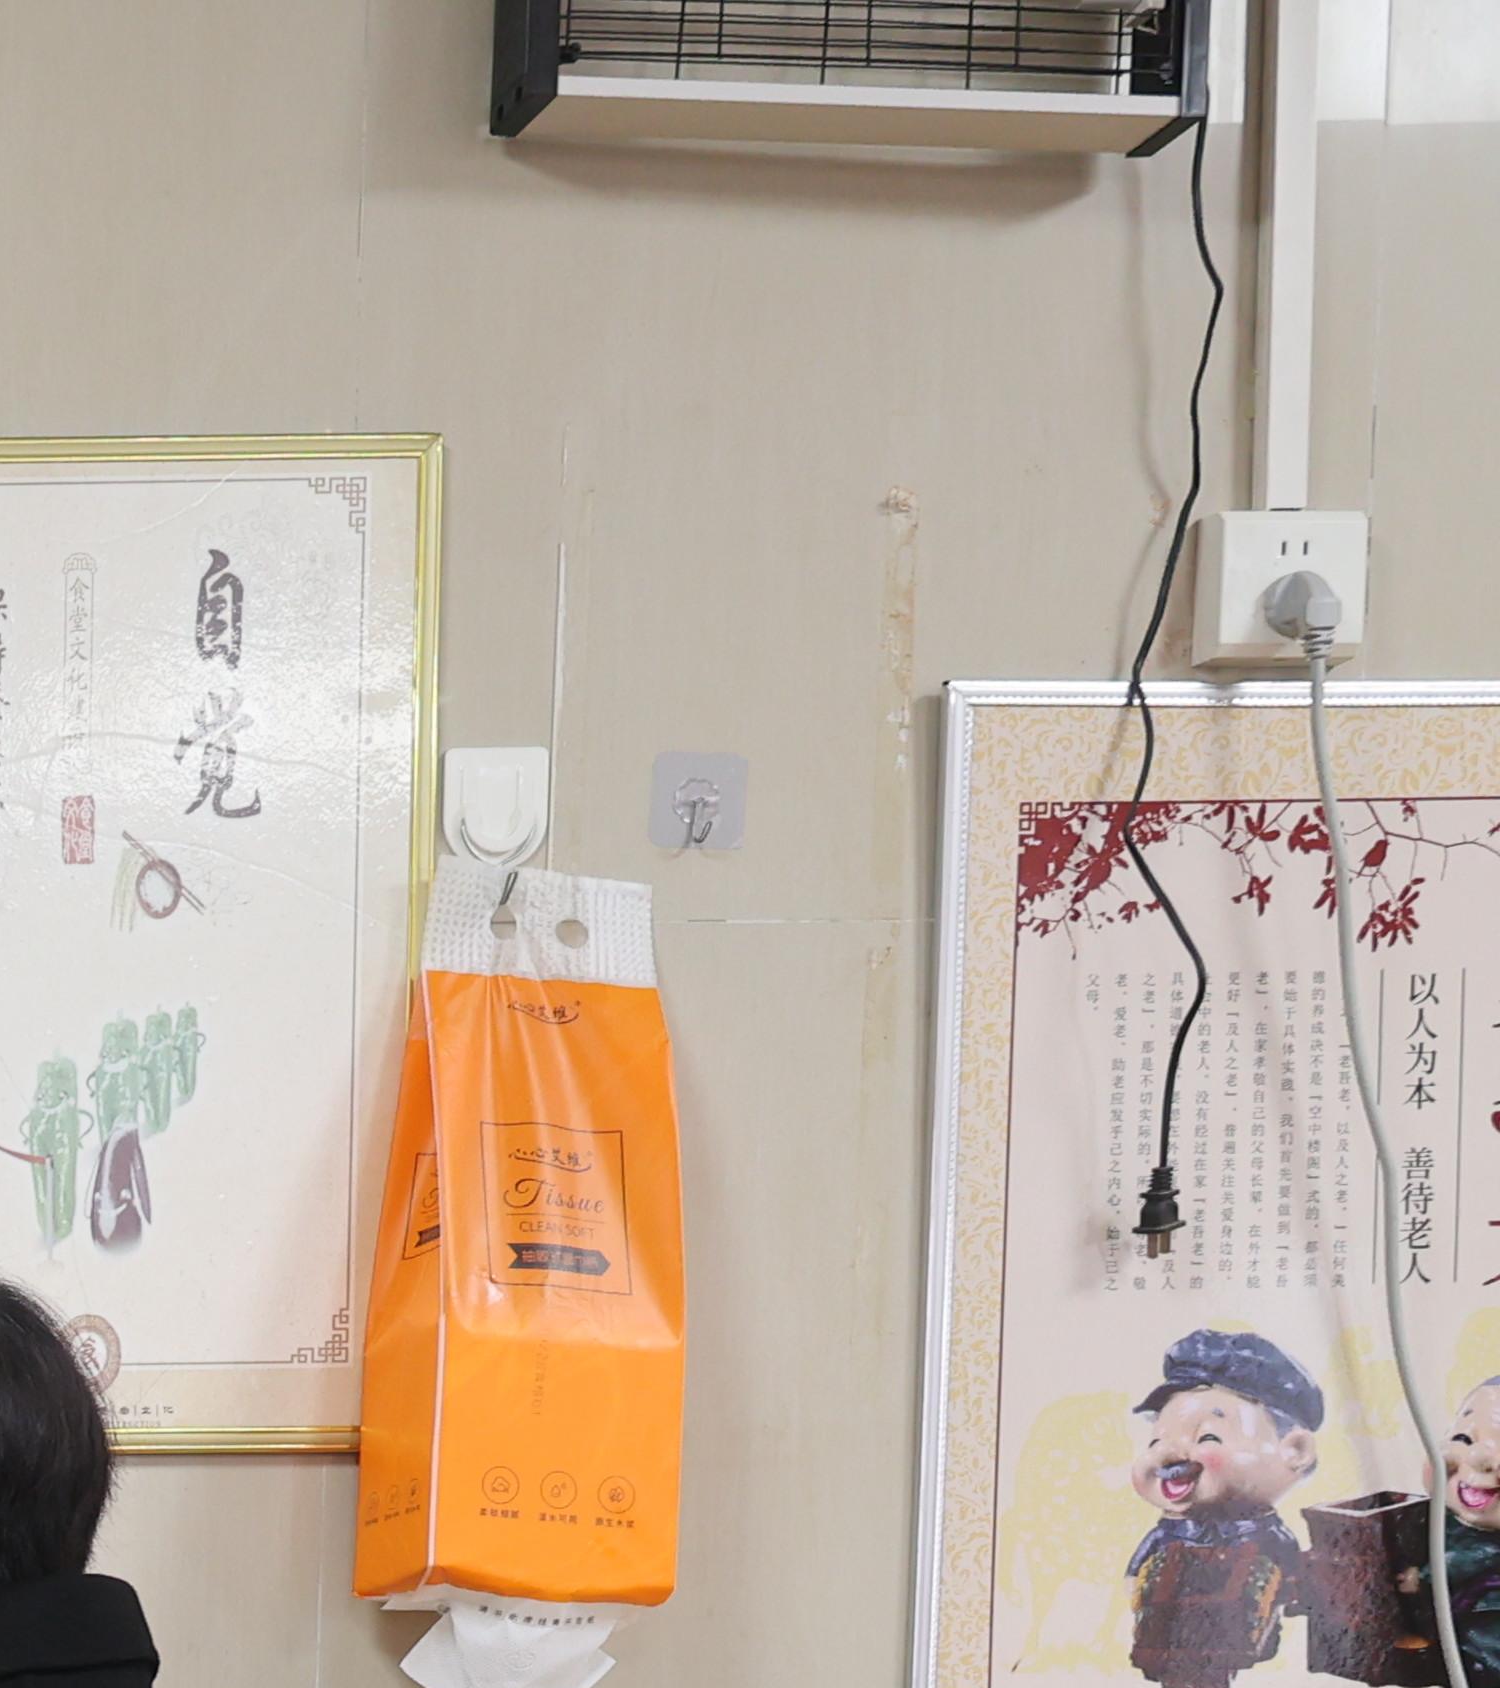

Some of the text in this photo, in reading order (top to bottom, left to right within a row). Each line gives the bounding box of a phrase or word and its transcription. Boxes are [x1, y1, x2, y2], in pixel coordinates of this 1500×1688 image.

[173, 549, 262, 819] 自觉
[1403, 972, 1440, 1110] 以人为本
[503, 1178, 604, 1213] Tissue
[1399, 1146, 1435, 1285] 善待老人
